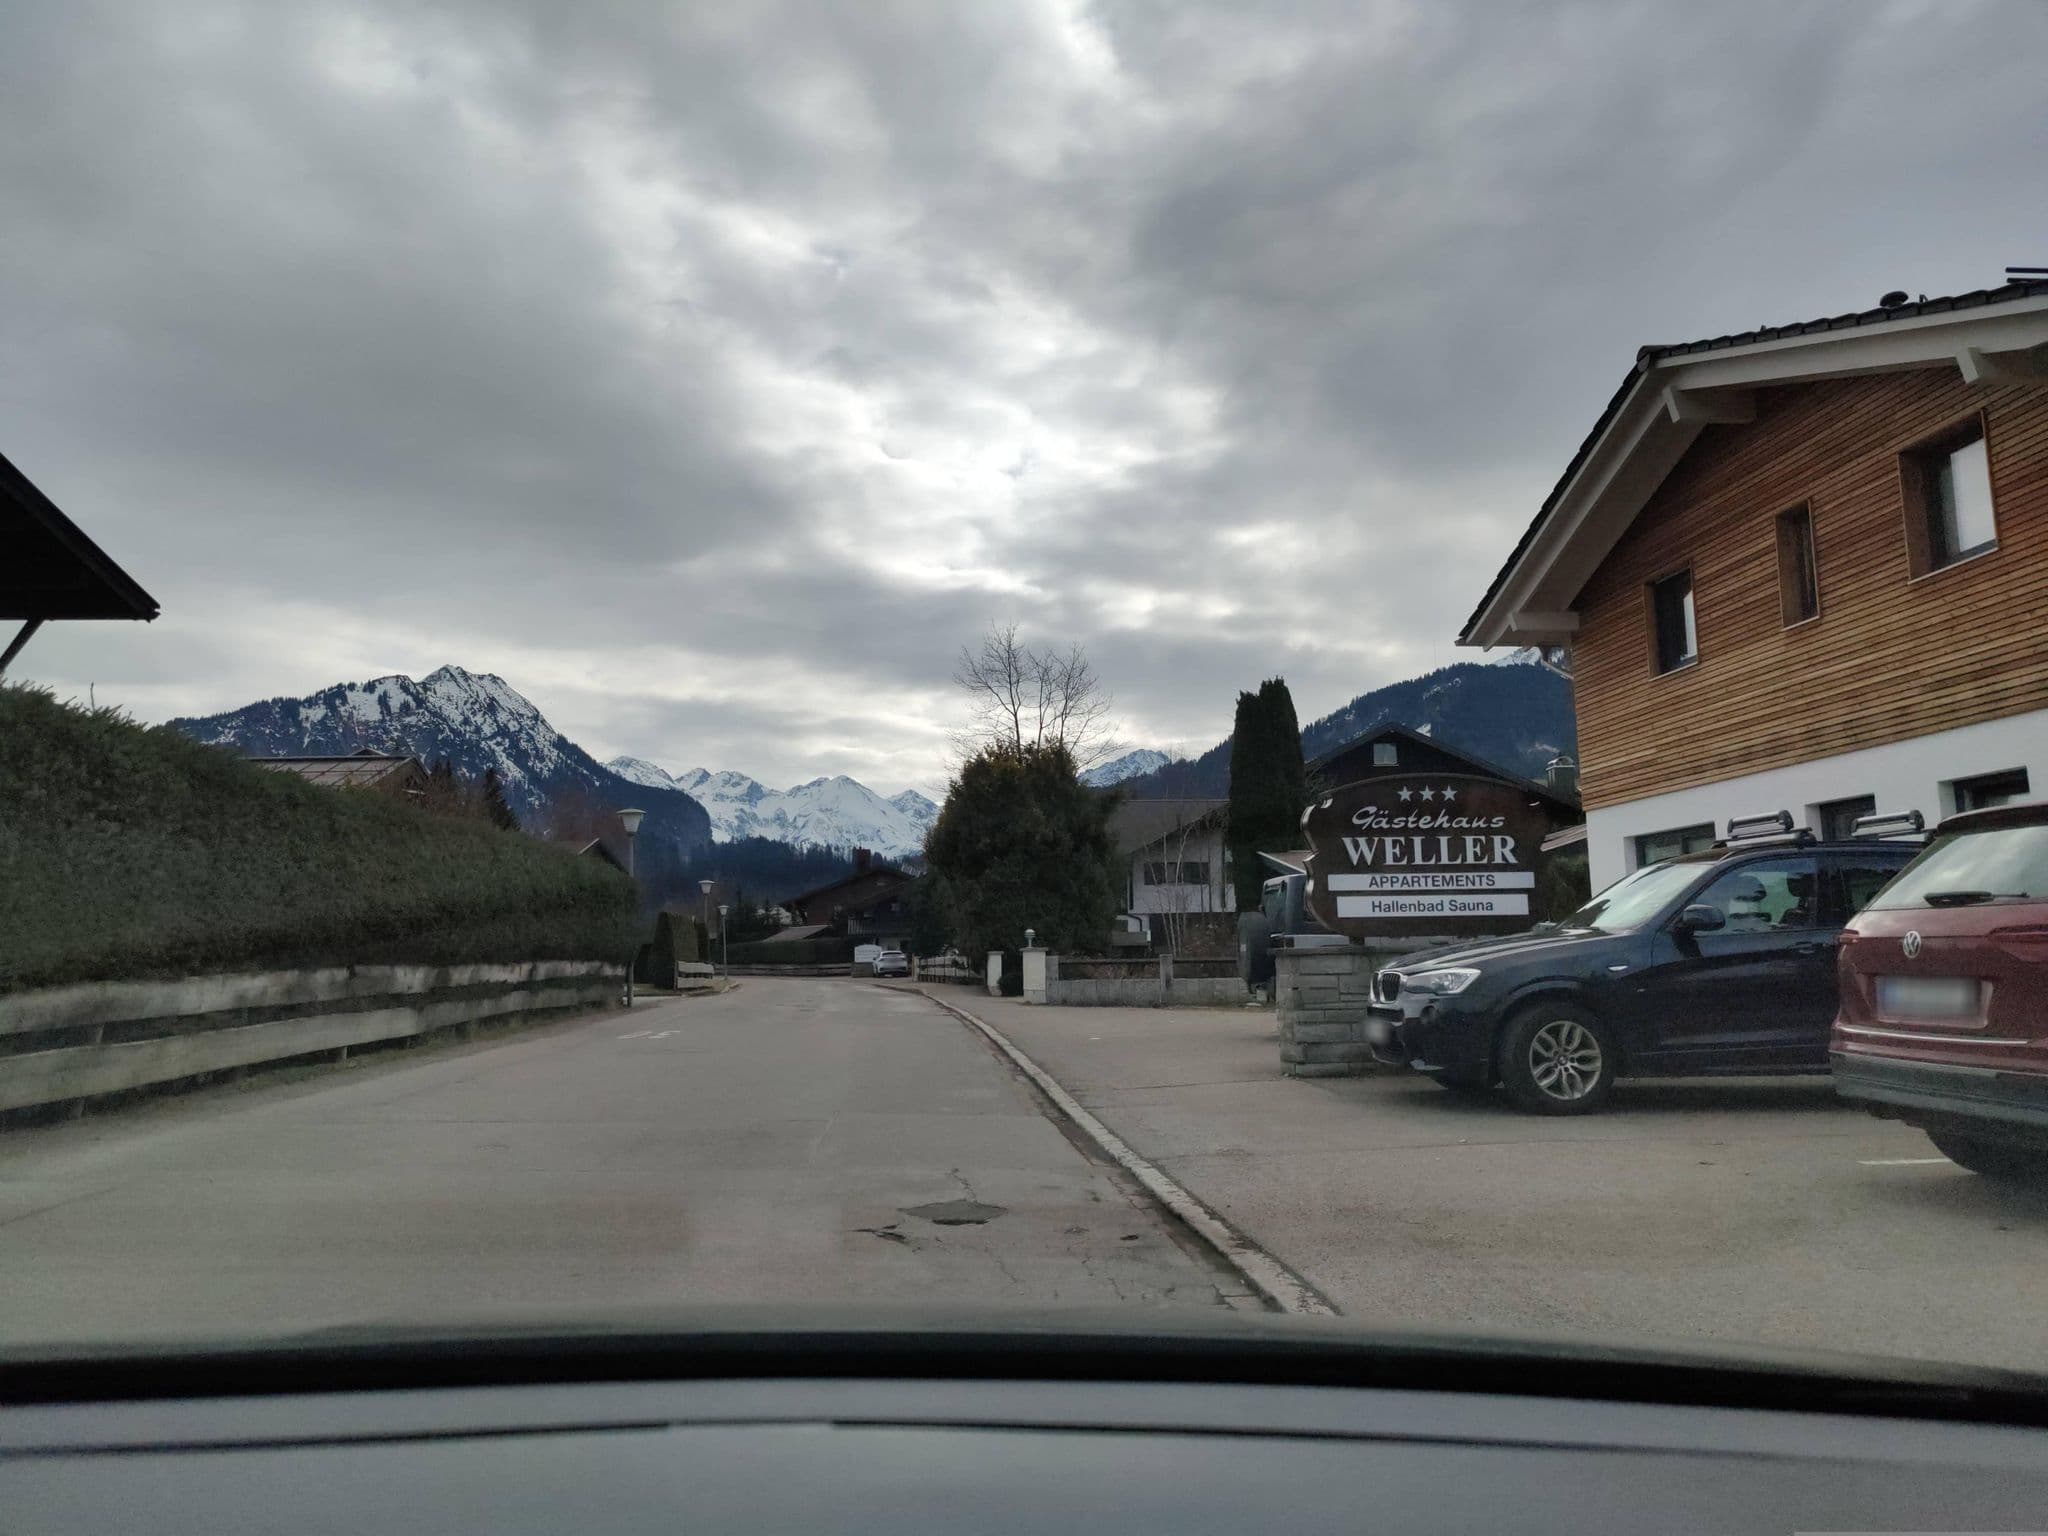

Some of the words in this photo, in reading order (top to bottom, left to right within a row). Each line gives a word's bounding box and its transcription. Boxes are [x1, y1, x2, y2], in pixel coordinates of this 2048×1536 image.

[1352, 806, 1506, 831] Gästehaus
[1342, 835, 1519, 866] WELLER
[1368, 874, 1496, 889] APPARTEMENTS
[1371, 899, 1444, 913] Hallenbad
[1448, 899, 1494, 912] Sauna
